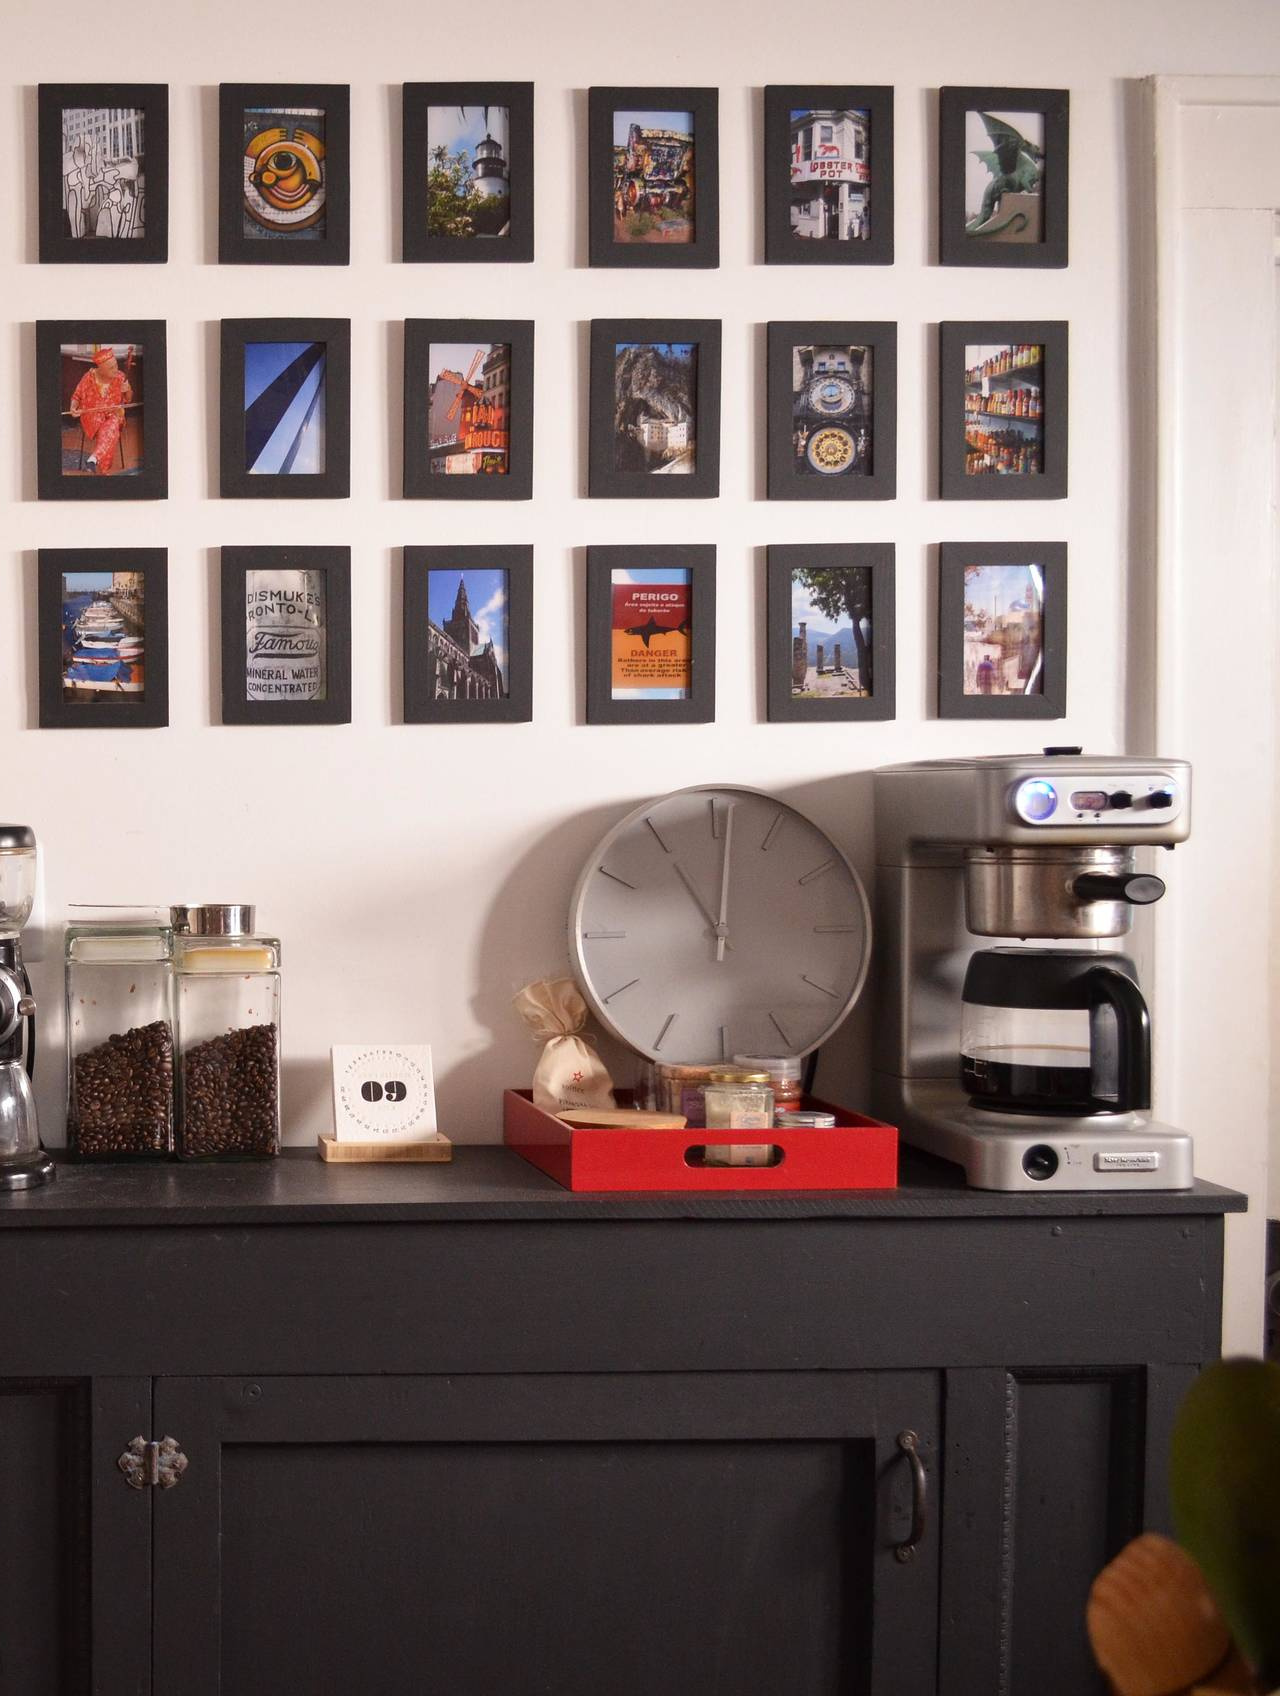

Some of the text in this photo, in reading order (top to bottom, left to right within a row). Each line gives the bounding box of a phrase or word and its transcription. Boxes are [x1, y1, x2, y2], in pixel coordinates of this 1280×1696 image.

[810, 161, 853, 173] LOBSTER
[820, 170, 843, 178] POT
[632, 592, 679, 601] PERIGO
[631, 649, 678, 657] DANGER
[247, 667, 319, 680] MINERAL WATER
[361, 1080, 408, 1103] 09
